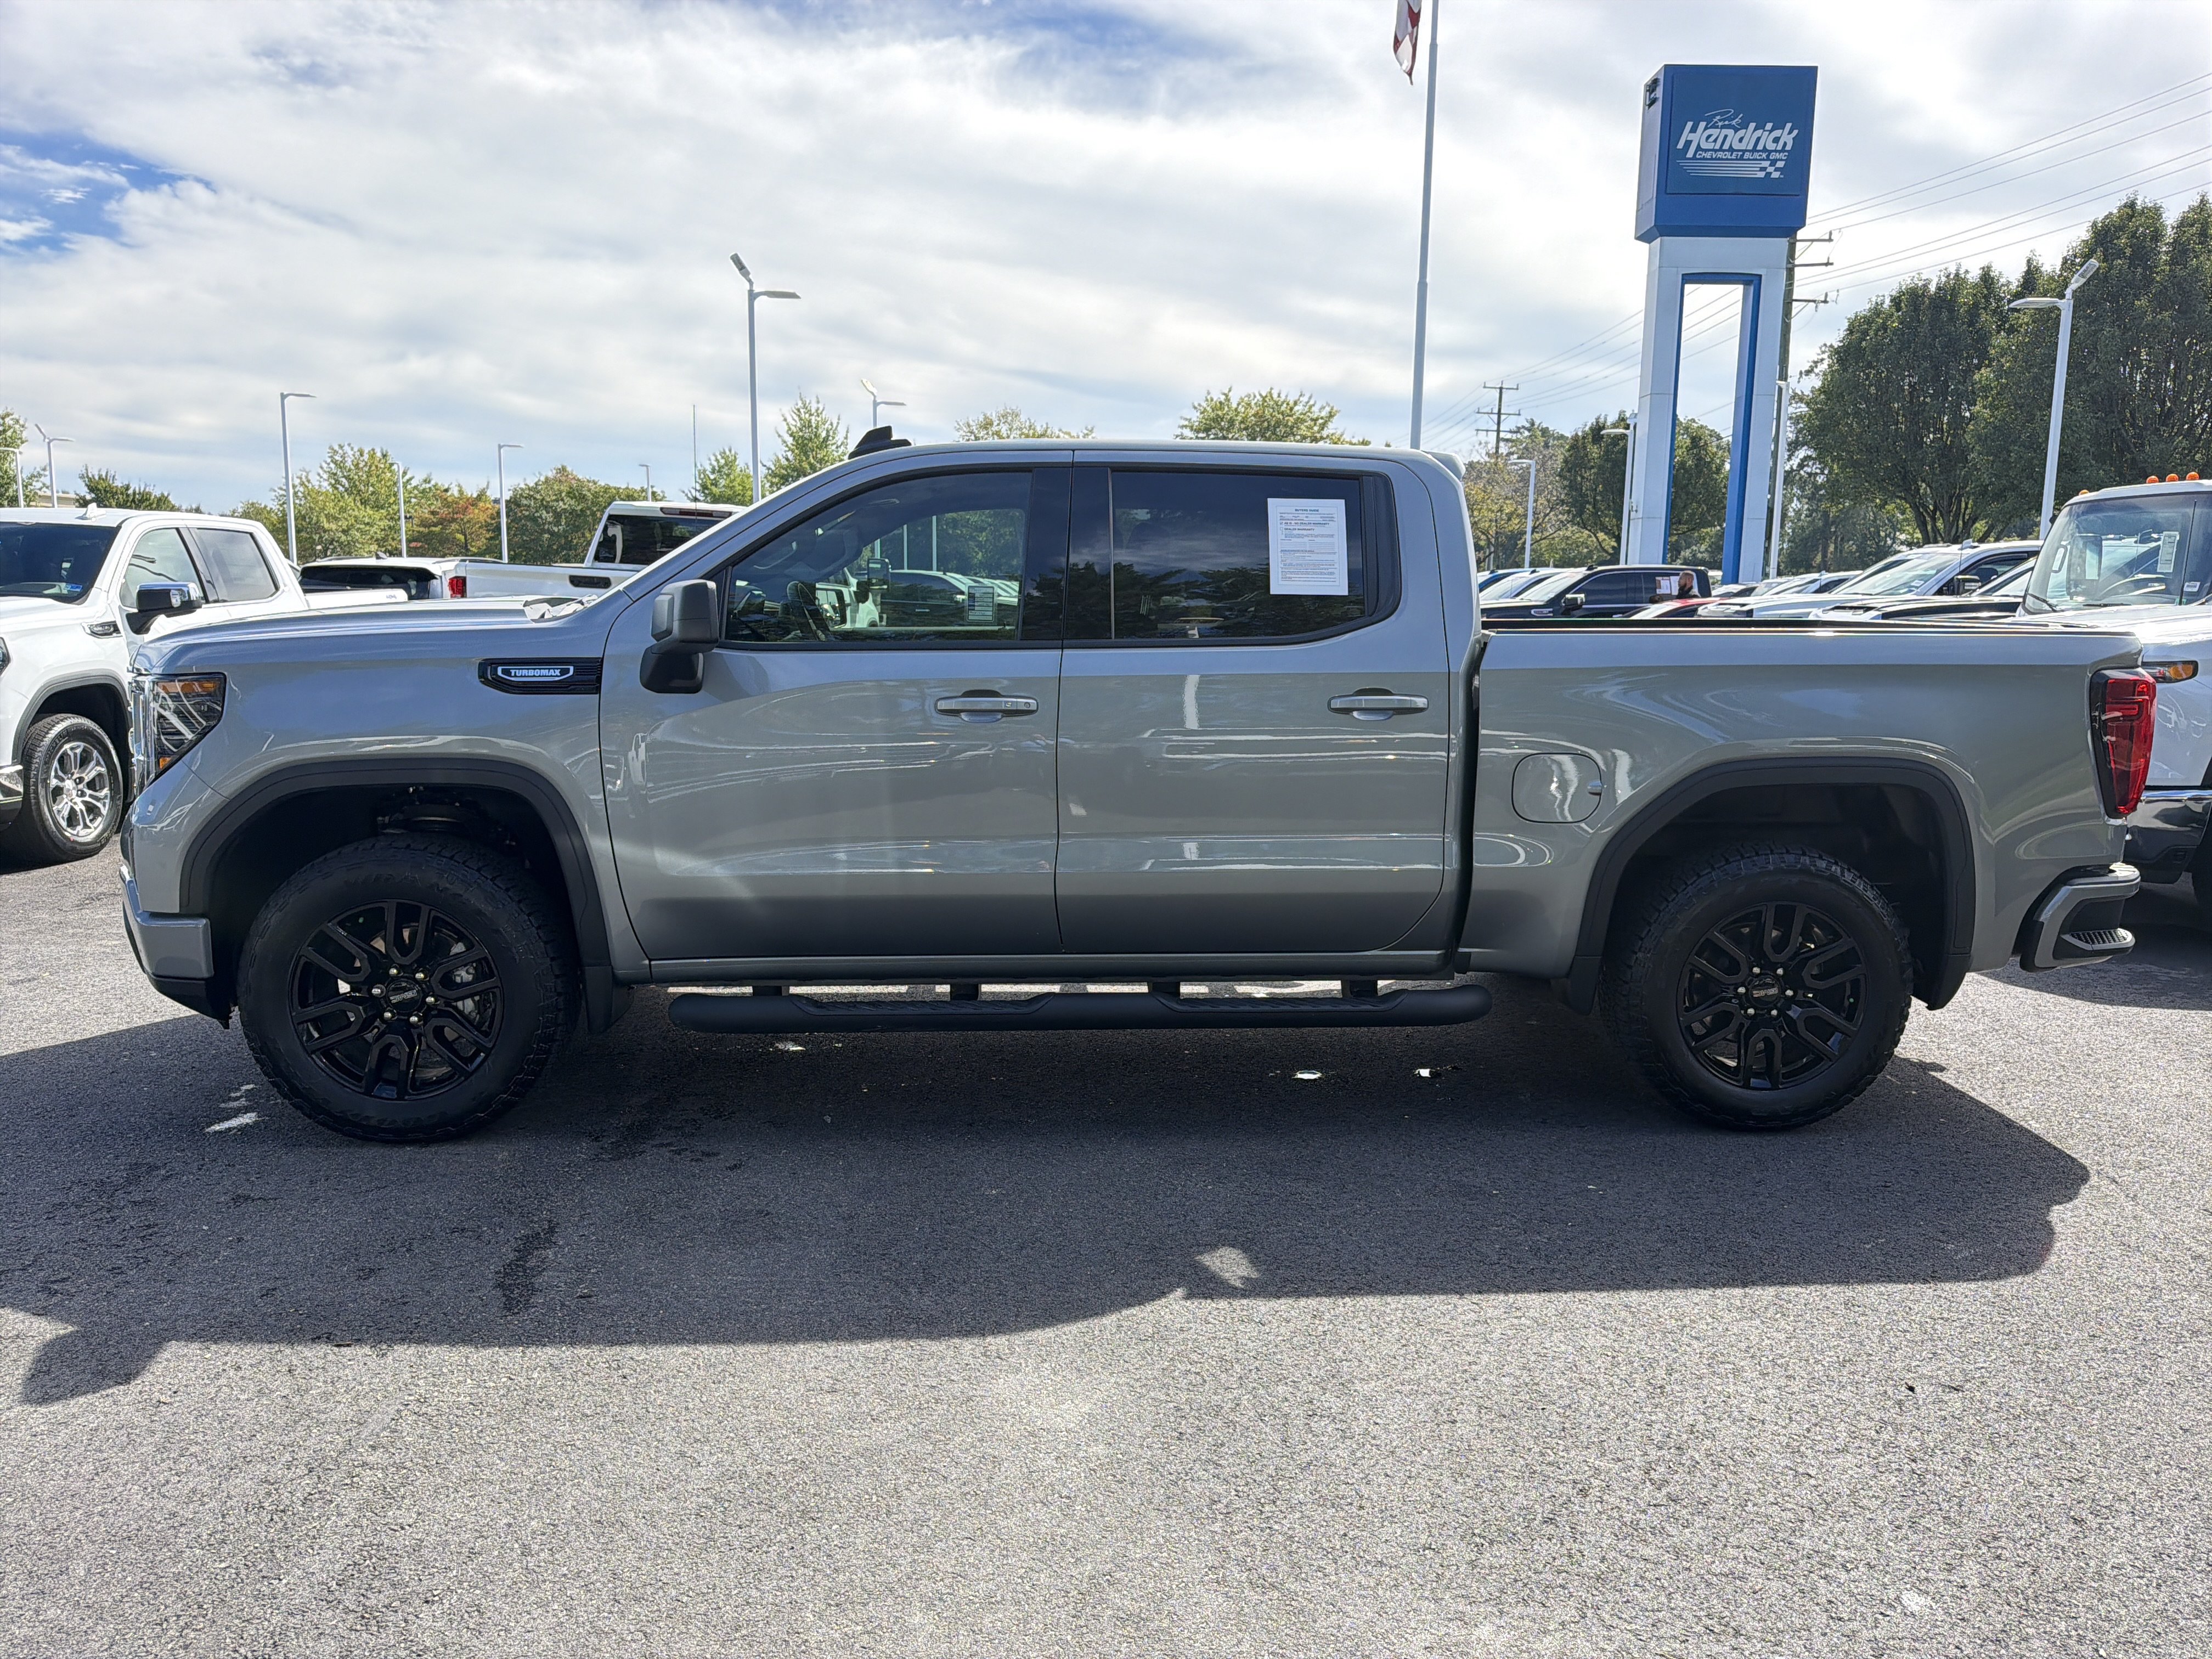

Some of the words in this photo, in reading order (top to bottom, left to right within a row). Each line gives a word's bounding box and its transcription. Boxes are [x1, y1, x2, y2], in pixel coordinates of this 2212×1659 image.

[1677, 121, 1799, 158] Hendrick
[1696, 151, 1742, 159] CHEVROLET
[389, 989, 417, 1004] GMC
[1752, 987, 1778, 997] GMC
